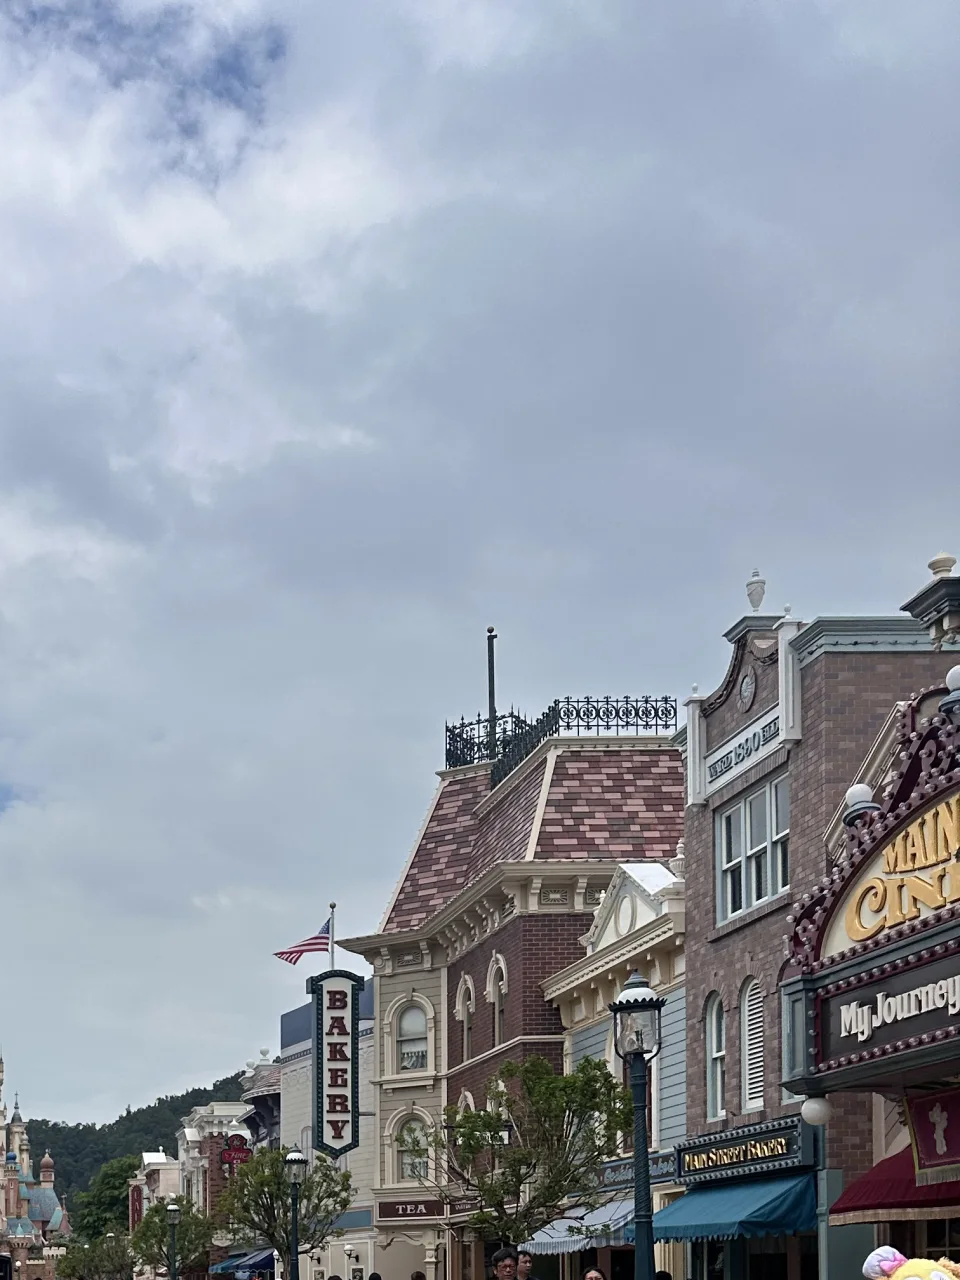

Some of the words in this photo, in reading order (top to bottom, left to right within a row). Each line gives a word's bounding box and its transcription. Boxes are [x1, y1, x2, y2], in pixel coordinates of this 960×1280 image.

[881, 791, 960, 874] MAIN
[840, 1000, 872, 1043] My
[872, 974, 960, 1029] Journey
[325, 990, 350, 1140] BAKERY
[684, 1151, 709, 1171] MAIN
[708, 1147, 746, 1167] STREET
[746, 1138, 788, 1160] BAKERY
[395, 1203, 428, 1215] TEA
